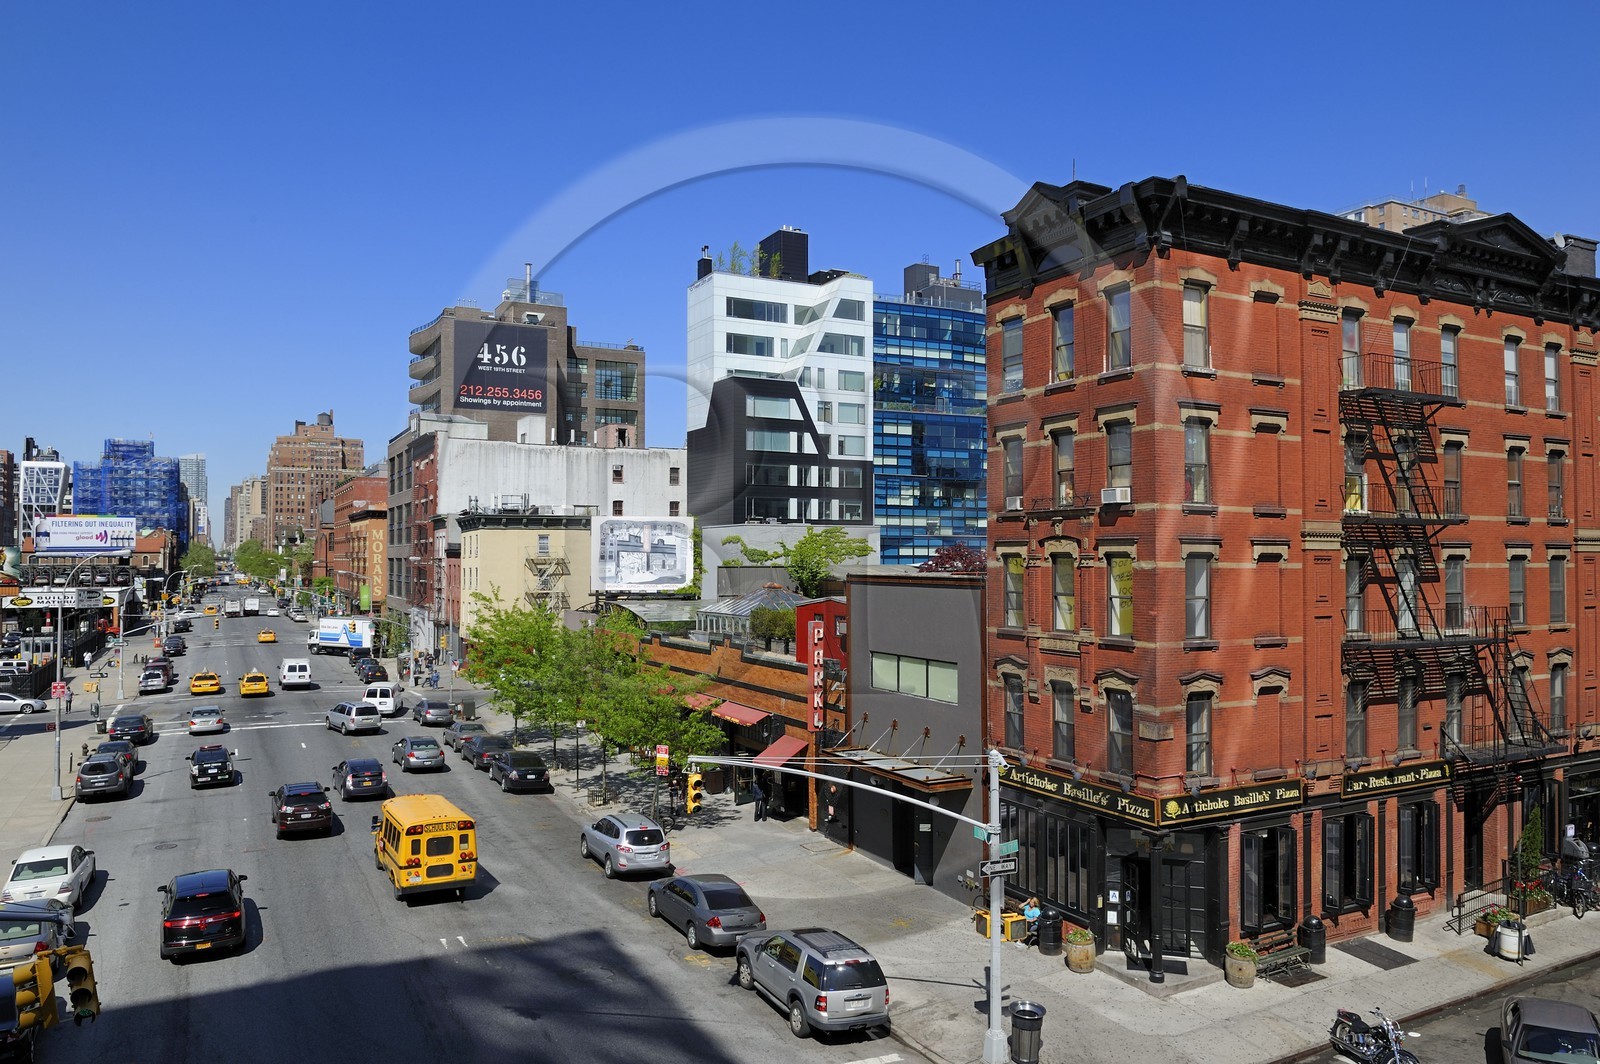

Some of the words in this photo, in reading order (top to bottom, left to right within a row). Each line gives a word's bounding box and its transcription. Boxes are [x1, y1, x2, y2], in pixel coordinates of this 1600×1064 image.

[477, 343, 527, 366] 456
[460, 384, 542, 400] 212.255.3456
[460, 396, 491, 405] Showings
[493, 398, 501, 406] by
[503, 399, 542, 408] appointment
[51, 520, 83, 528] FILTERING
[85, 520, 97, 528] OUT
[98, 520, 134, 528] INEQUALITY
[1420, 768, 1442, 780] Pizza
[1010, 768, 1058, 792] Artichoke
[1117, 797, 1151, 819] Pizza
[1275, 787, 1300, 800] Pizza
[424, 823, 444, 833] SCHOOL
[446, 821, 457, 830] BUS
[985, 864, 997, 872] ONE
[1001, 862, 1013, 870] WAY
